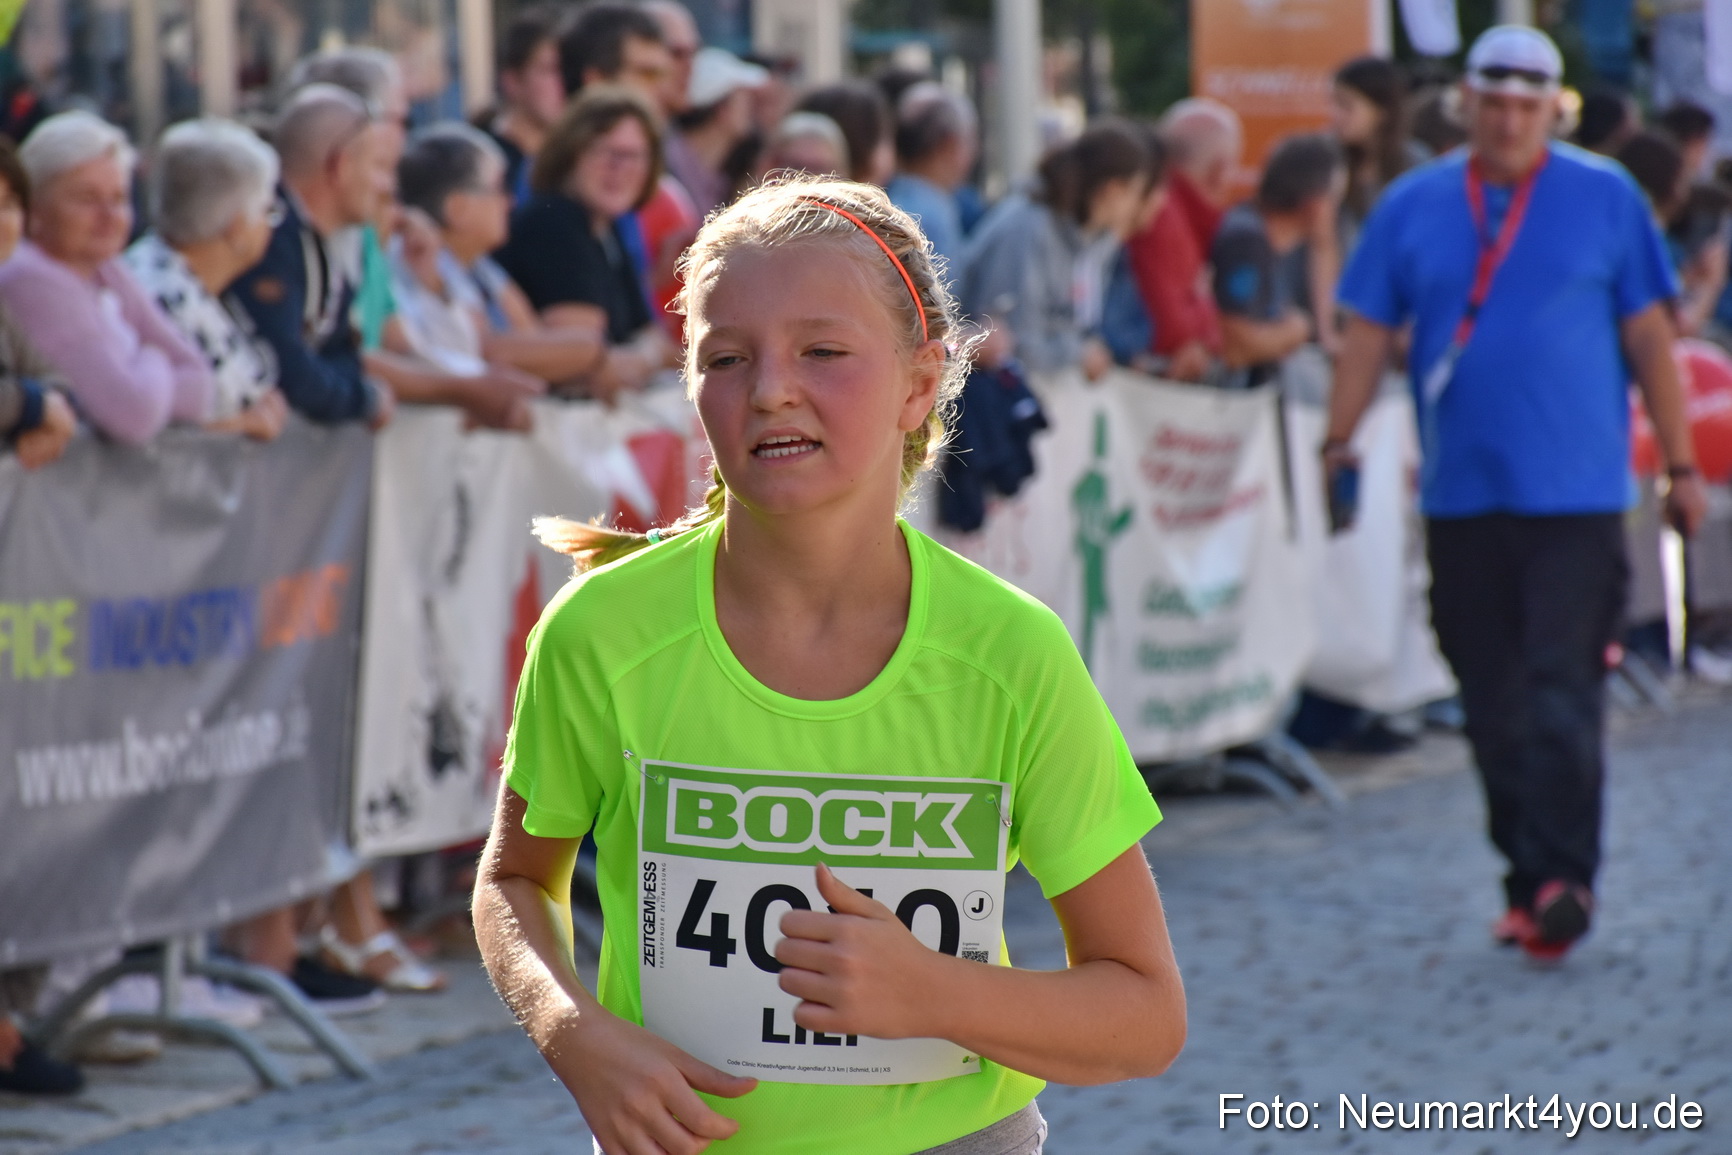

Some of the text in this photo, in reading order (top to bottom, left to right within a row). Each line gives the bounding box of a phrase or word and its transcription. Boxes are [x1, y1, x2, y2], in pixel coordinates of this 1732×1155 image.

[666, 778, 974, 858] BOCK
[676, 879, 960, 974] 400
[971, 898, 984, 913] J
